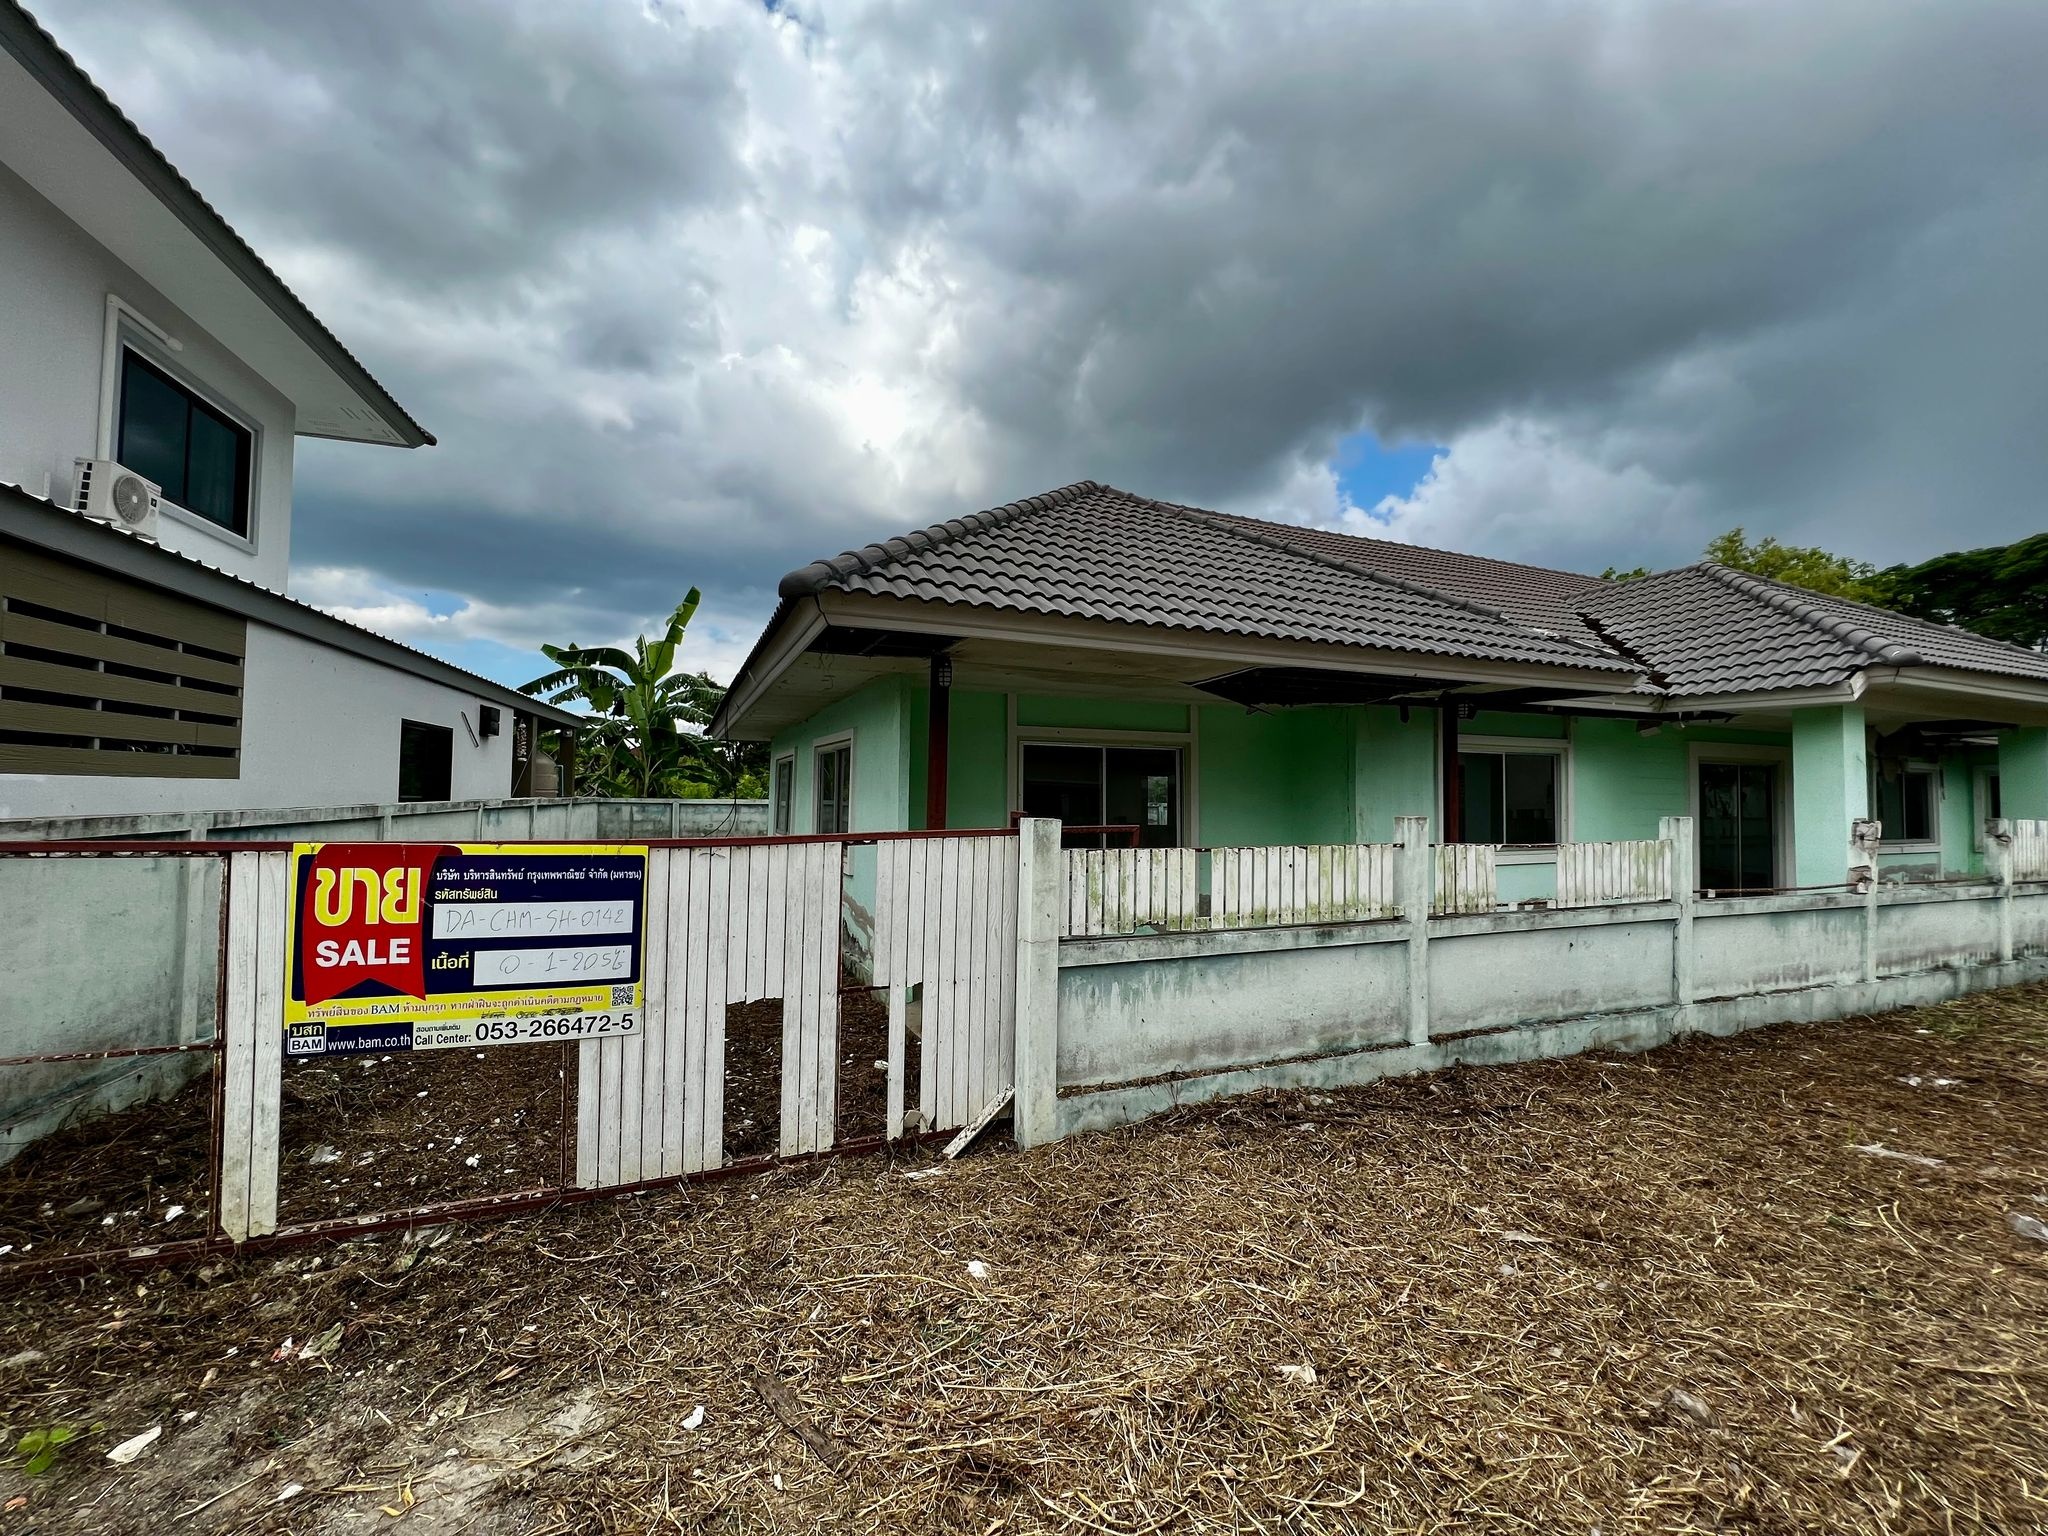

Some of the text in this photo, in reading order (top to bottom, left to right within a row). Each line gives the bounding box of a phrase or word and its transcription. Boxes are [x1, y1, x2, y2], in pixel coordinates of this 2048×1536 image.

[436, 867, 642, 884] บริษัท บริหารสินทรัพย์ กรุงเทพพาณิชย์ จำกัด (มหาชน)
[314, 867, 421, 927] ขาย
[434, 887, 498, 900] รหัสทรัพย์สิน
[315, 938, 411, 968] SALE
[431, 951, 470, 970] เนื้อที่
[307, 1006, 369, 1019] ทรัพย์สินของ
[370, 1003, 401, 1015] BAM
[403, 1001, 447, 1014] ห้ามบุกรุก
[291, 1025, 323, 1037] บสก
[475, 1013, 634, 1041] 053-266472-5
[291, 1038, 323, 1051] BAM
[327, 1034, 411, 1051] www.bam.co.th
[414, 1033, 472, 1046] Call Center:
